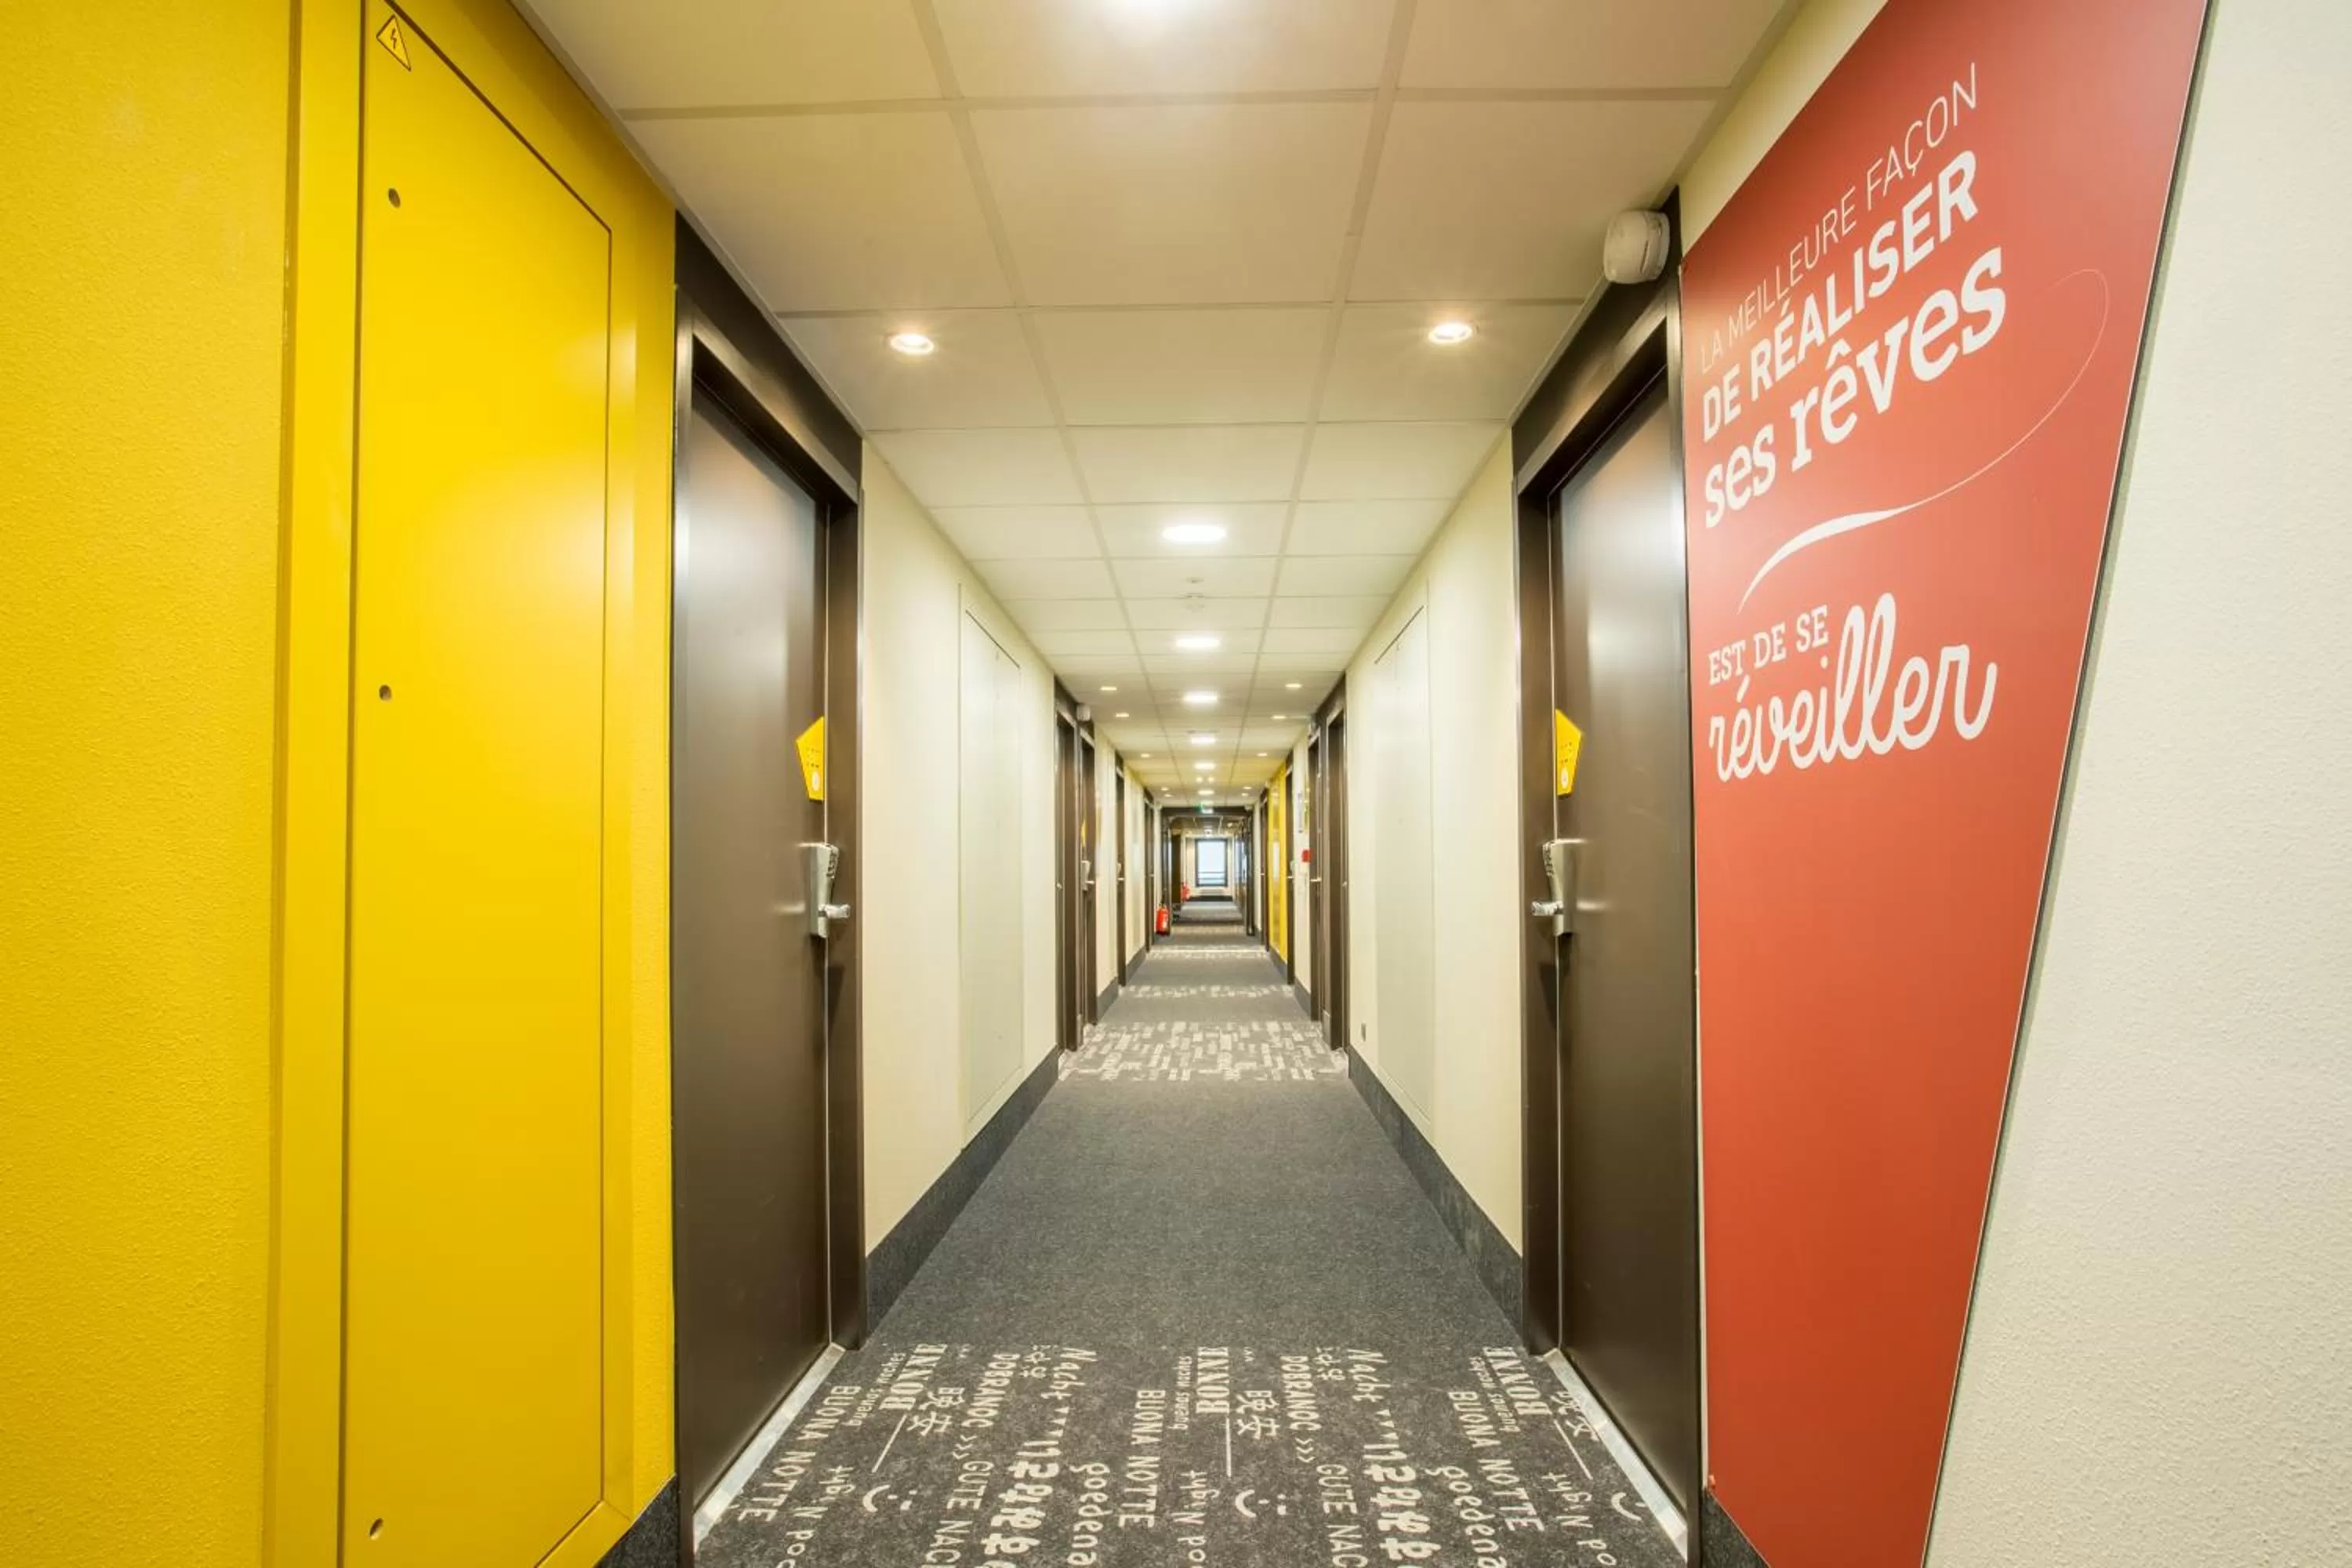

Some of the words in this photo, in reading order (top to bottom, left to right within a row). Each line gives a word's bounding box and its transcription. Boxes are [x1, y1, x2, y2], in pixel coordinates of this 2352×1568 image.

[1700, 336, 1724, 375] LA
[1729, 187, 1857, 340] MEILLEURE
[1867, 62, 1978, 212] FAÇON
[1702, 365, 1741, 441] DE
[1750, 151, 1978, 401] RÉALISER
[1704, 423, 1776, 528] ses
[1789, 246, 2007, 472] rêves
[1708, 640, 1746, 685] EST
[1754, 624, 1787, 670] DE
[1797, 605, 1829, 652] SE
[1708, 592, 1998, 782] réveiller
[960, 1353, 1021, 1428] DOBRANOC
[1040, 1348, 1097, 1399] Nacht
[1196, 1347, 1229, 1414] BONNE
[1279, 1356, 1322, 1431] DOBRANOC
[1347, 1348, 1392, 1403] Nacht
[797, 1385, 862, 1440] BUONA
[1131, 1390, 1166, 1445] BUONA
[737, 1451, 816, 1522] NOTTE
[792, 1465, 856, 1519] Night
[946, 1461, 994, 1509] GUTE
[1118, 1455, 1160, 1527] NOTTE
[1316, 1464, 1357, 1515] GUTE
[1449, 1391, 1501, 1449] BUONA
[1477, 1459, 1545, 1531] NOTTE
[1067, 1462, 1113, 1566] goedena
[1171, 1470, 1220, 1525] Night
[1363, 1443, 1442, 1568] すみなさい
[1425, 1465, 1507, 1568] goedena
[1541, 1472, 1594, 1529] Night
[775, 1530, 815, 1568] ood
[921, 1519, 973, 1568] NAC
[1326, 1524, 1368, 1568] NAC
